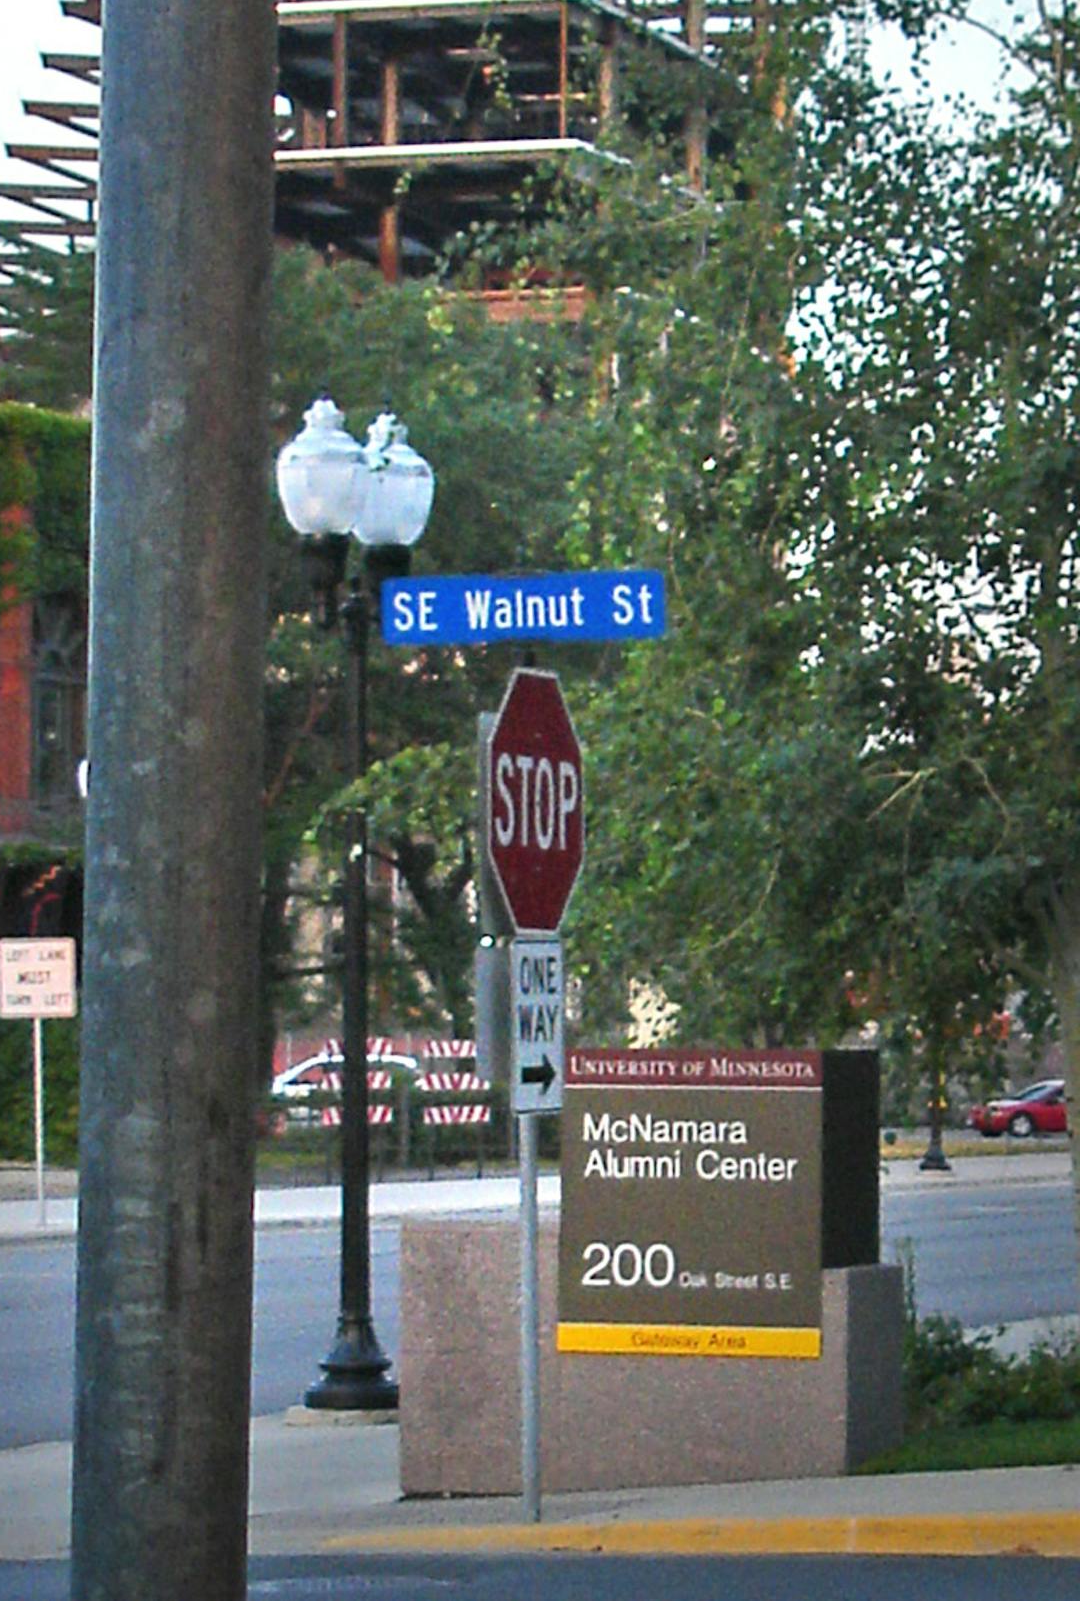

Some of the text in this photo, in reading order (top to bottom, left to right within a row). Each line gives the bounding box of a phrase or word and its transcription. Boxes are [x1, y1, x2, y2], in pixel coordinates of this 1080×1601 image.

[393, 584, 653, 632] SE Walnut St
[494, 752, 579, 850] STOP
[520, 956, 557, 994] ONE
[518, 1004, 559, 1042] WAY
[570, 1055, 815, 1079] UNIVERSITY OF MINNESOTA
[582, 1113, 748, 1144] McNamara
[584, 1148, 799, 1181] Alumni Center
[581, 1242, 676, 1287] 200
